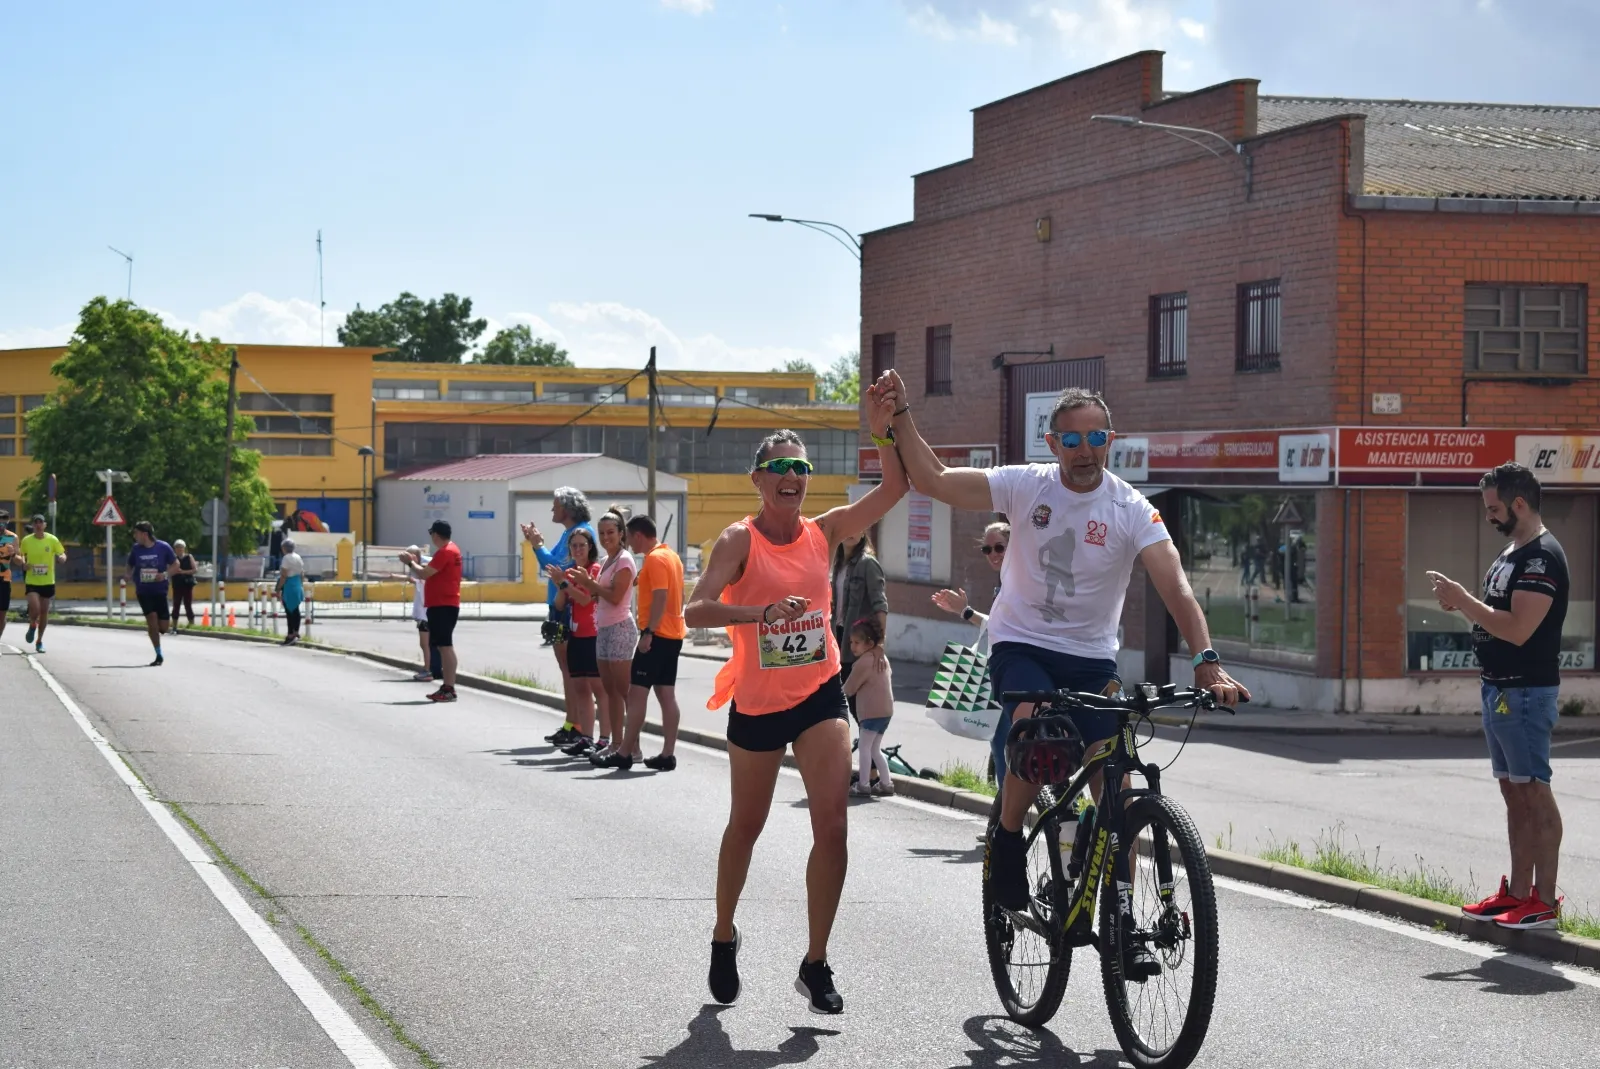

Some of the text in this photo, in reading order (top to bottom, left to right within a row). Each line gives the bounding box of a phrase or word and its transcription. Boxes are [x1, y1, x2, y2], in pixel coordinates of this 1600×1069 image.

[1355, 432, 1486, 447] ASISTENCIA TECNICA
[1367, 451, 1474, 465] MANTENIMIENTO
[1086, 520, 1107, 538] 23
[759, 615, 824, 636] bedunia
[782, 634, 808, 653] 42
[1081, 826, 1108, 912] STEVENS
[1118, 889, 1131, 916] FOX
